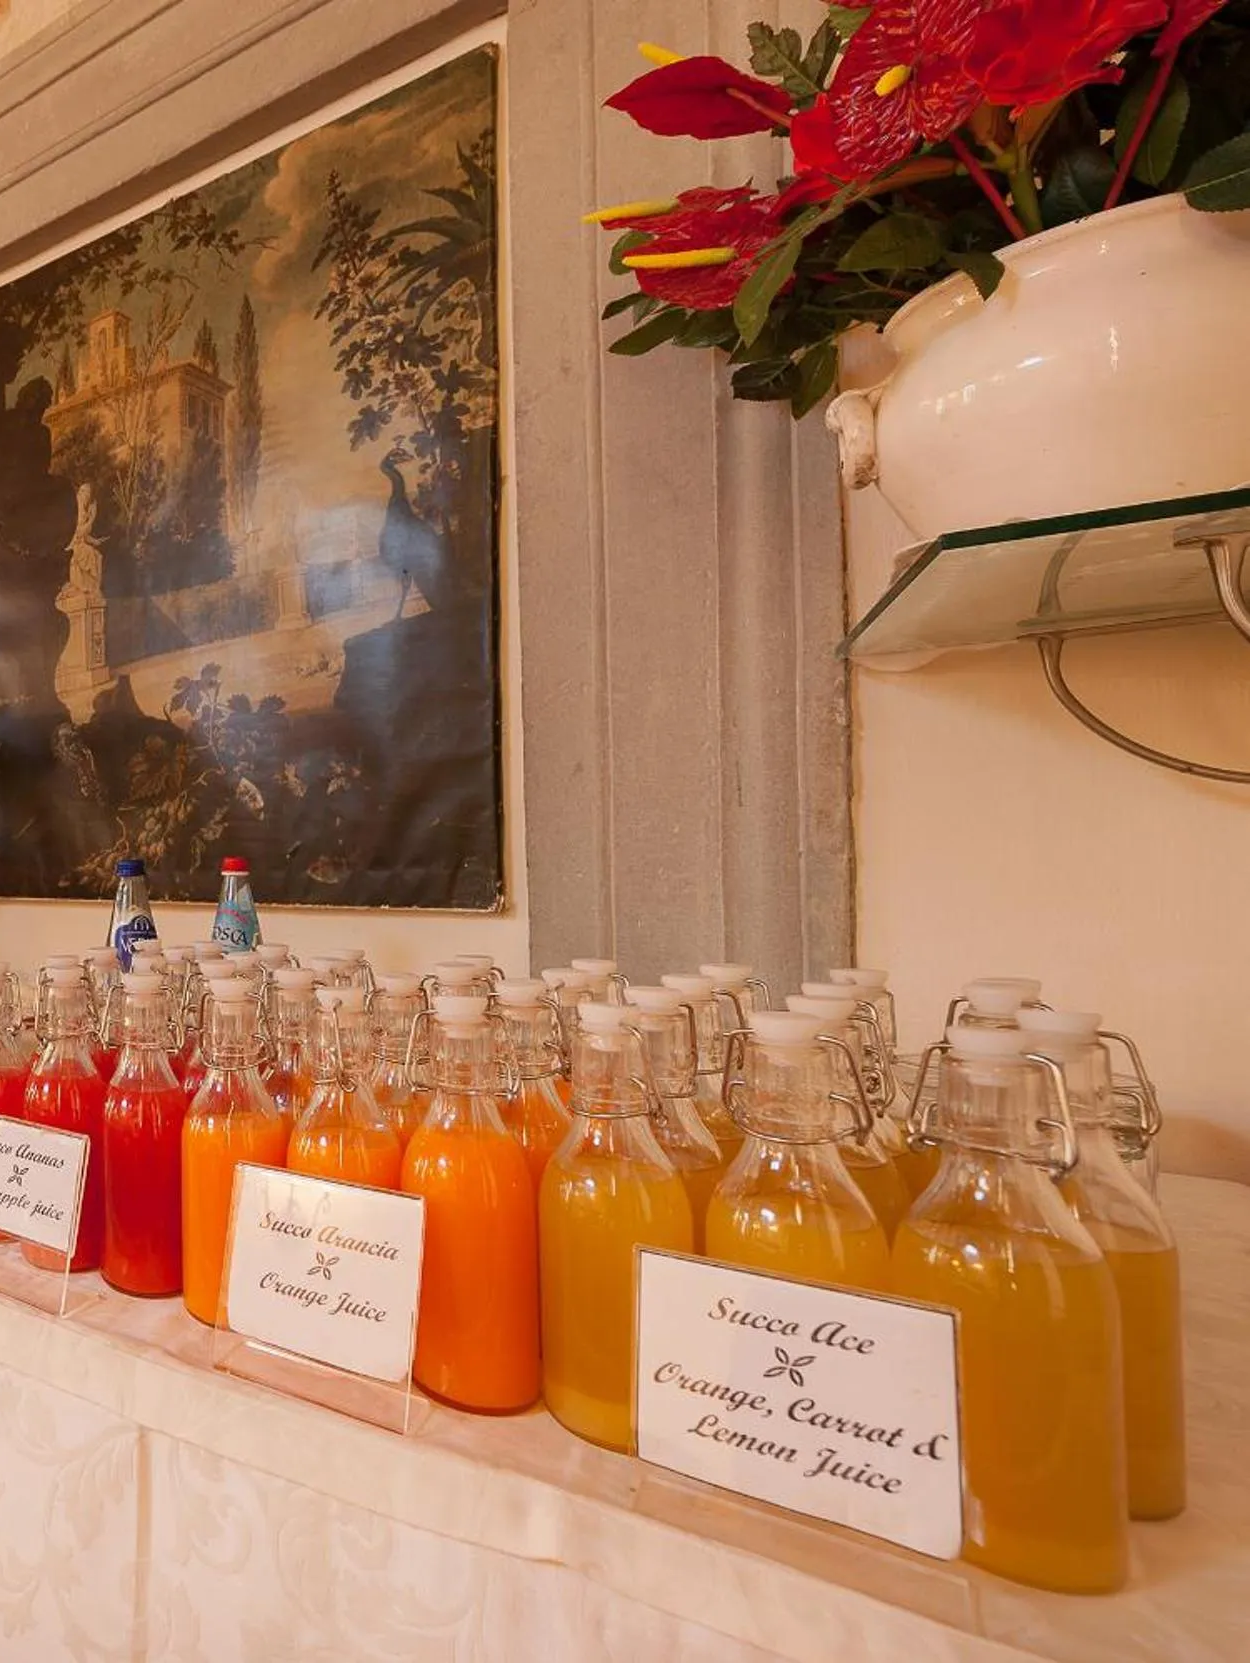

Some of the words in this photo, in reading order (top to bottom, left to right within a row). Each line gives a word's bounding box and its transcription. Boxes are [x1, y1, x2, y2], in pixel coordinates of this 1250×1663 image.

[15, 1143, 65, 1169] Ananas
[30, 1199, 64, 1221] juice
[259, 1211, 313, 1238] Succo
[317, 1225, 399, 1261] Arancia
[259, 1272, 328, 1308] Orange
[331, 1292, 387, 1322] Juice
[707, 1297, 800, 1336] Succo
[811, 1320, 875, 1355] Ace
[653, 1362, 773, 1418] Orange,
[788, 1397, 903, 1448] Carrot
[912, 1433, 949, 1461] &
[687, 1413, 797, 1463] Lemon
[803, 1448, 902, 1494] Juice
